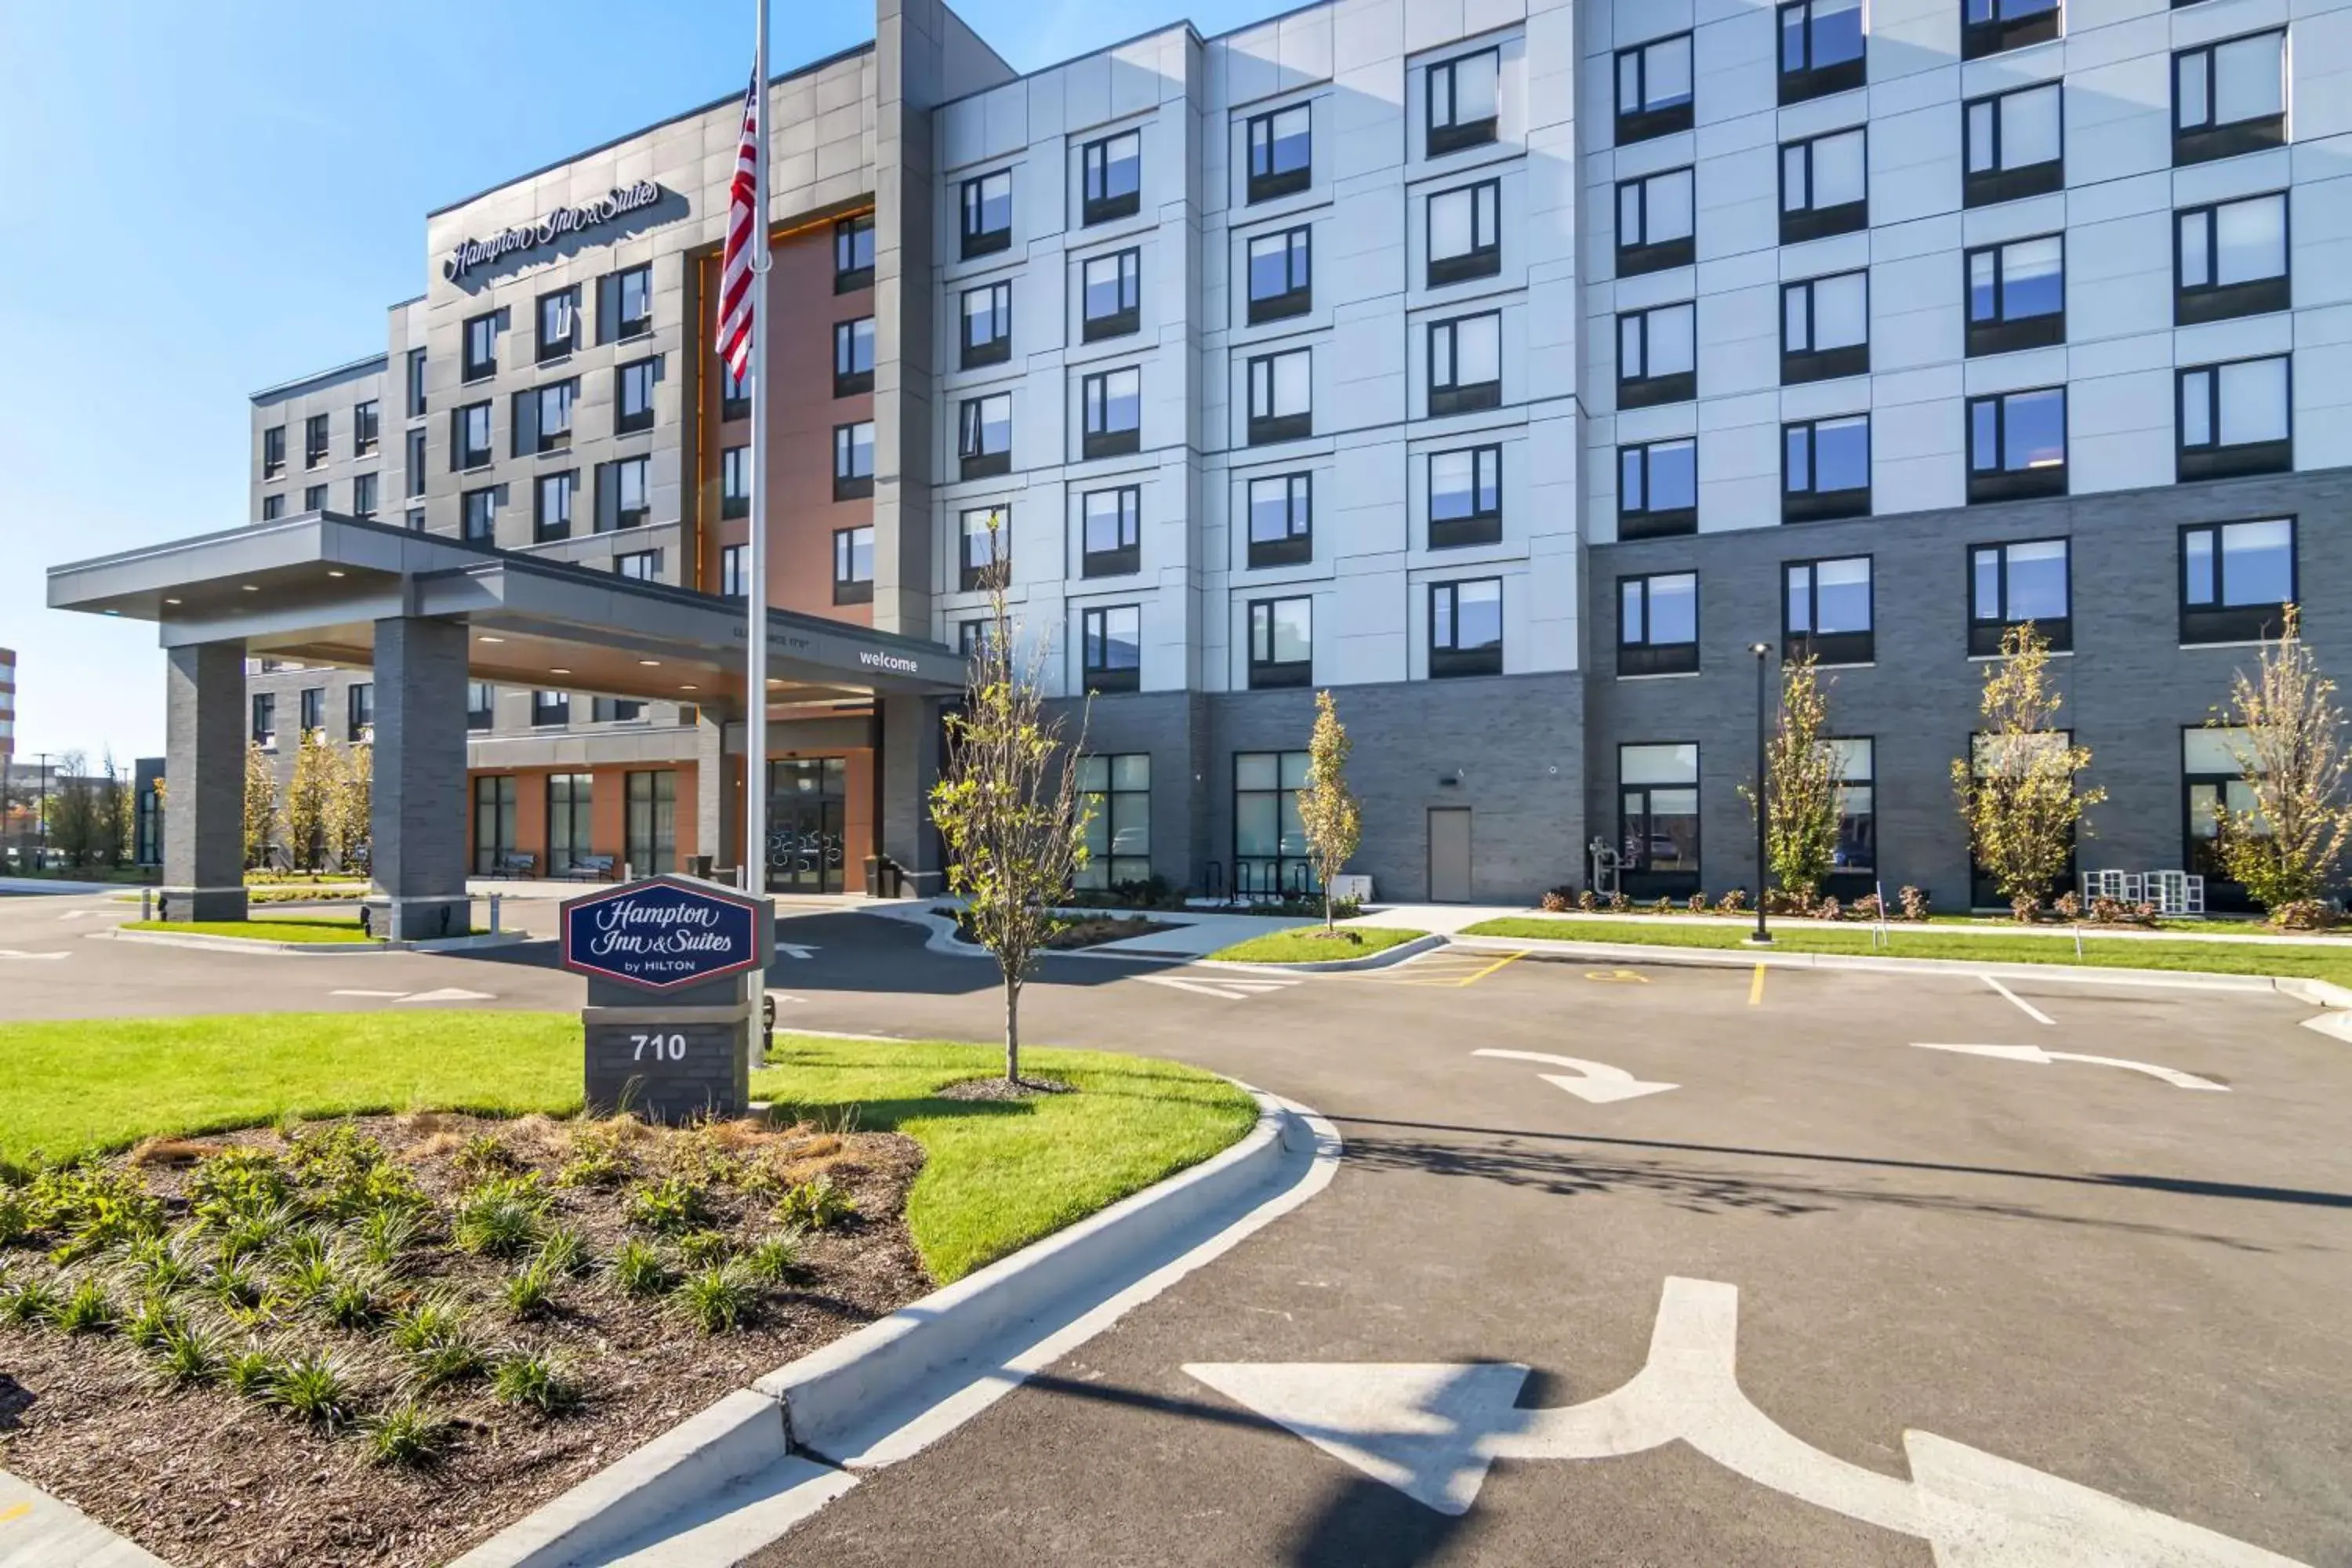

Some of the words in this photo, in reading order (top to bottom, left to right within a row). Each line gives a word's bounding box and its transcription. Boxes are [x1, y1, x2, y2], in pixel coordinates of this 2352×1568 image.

[444, 227, 535, 281] Hampton
[537, 207, 587, 244] Inn
[599, 179, 659, 219] Suites
[859, 651, 918, 672] welcome
[596, 899, 720, 931] Hampton
[590, 929, 653, 956] Inn
[653, 935, 669, 954] &
[667, 929, 732, 953] Suites
[625, 961, 641, 973] by
[644, 960, 696, 971] HILTON
[630, 1033, 688, 1061] 710
